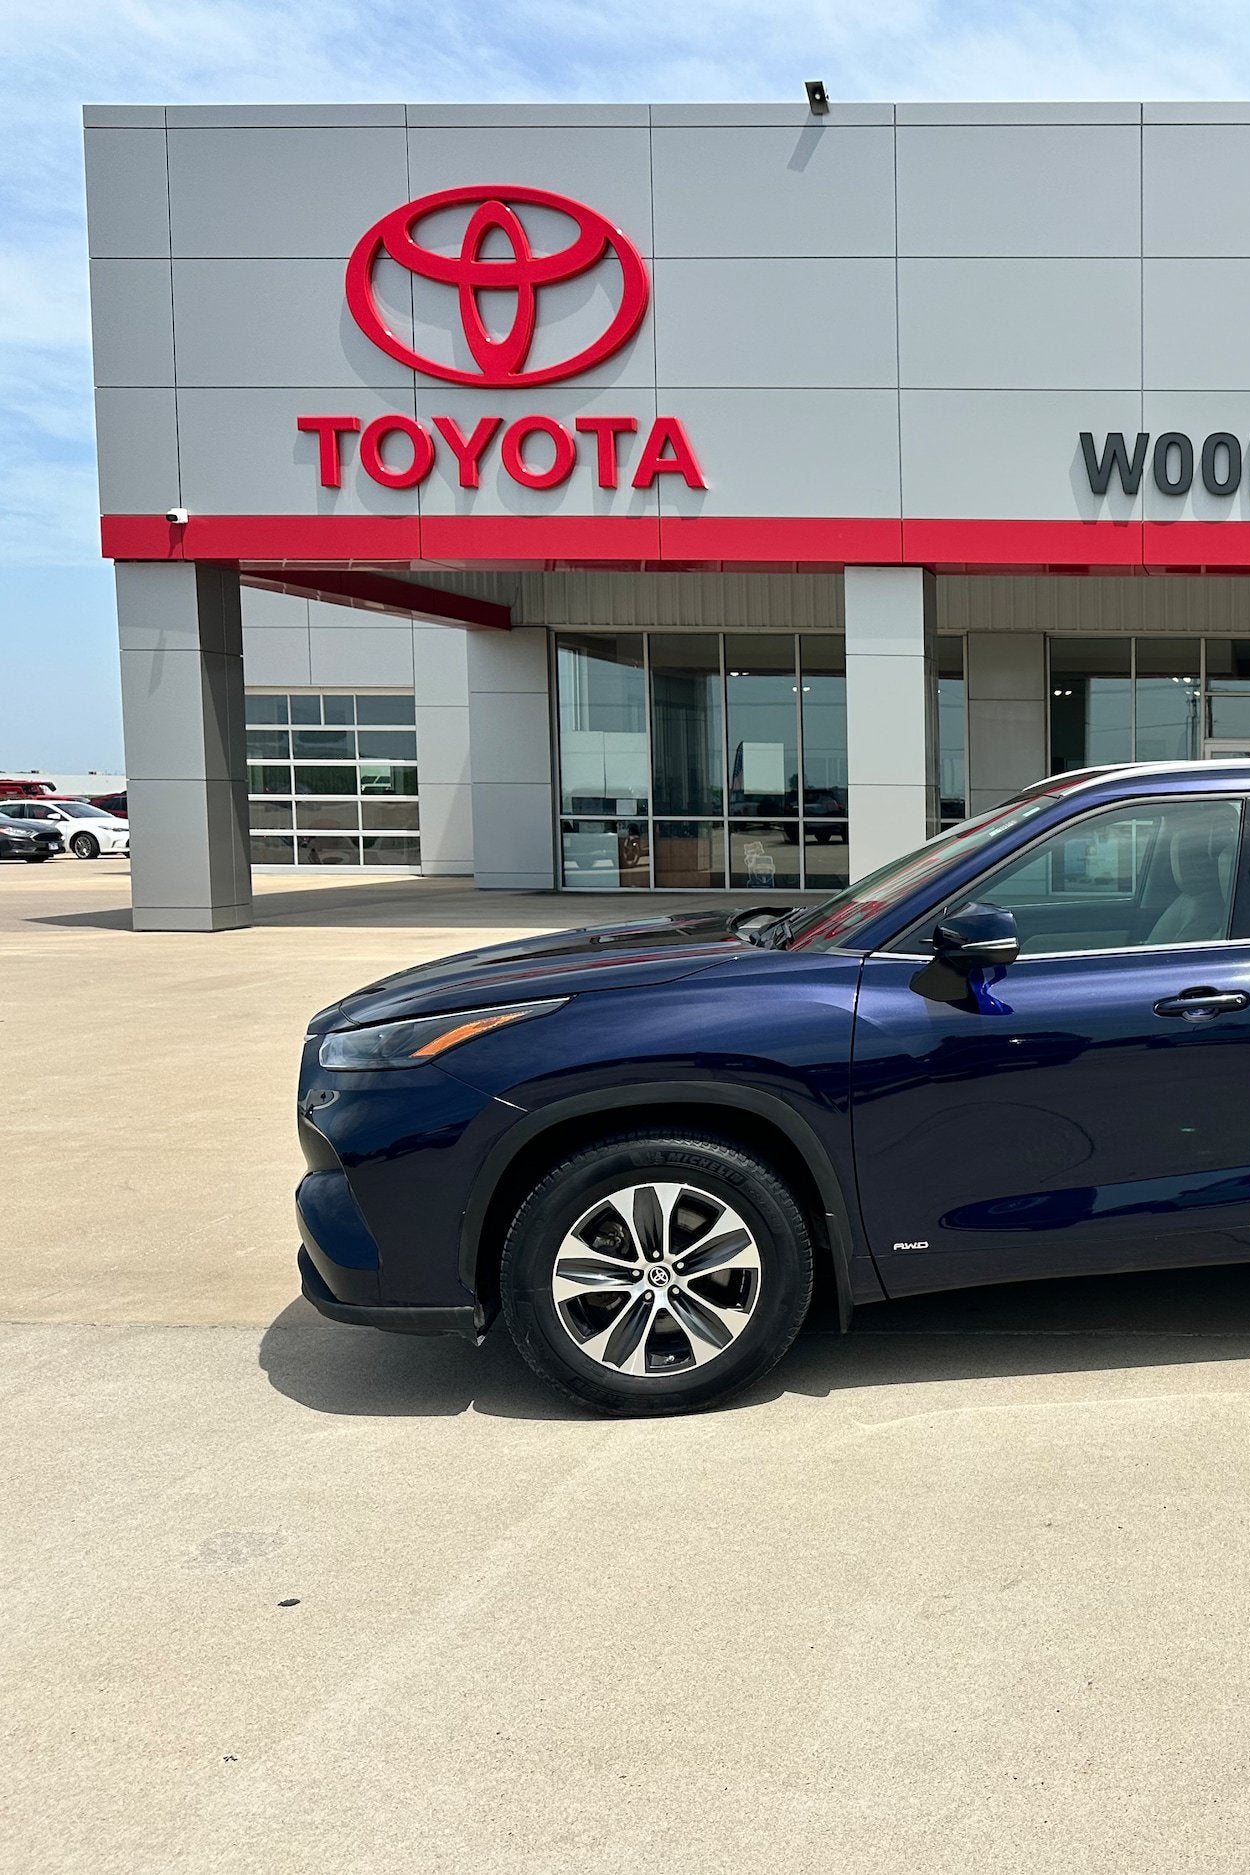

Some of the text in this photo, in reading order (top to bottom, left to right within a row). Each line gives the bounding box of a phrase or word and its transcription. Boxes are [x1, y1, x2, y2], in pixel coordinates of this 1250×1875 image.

[297, 414, 709, 490] TOYOTA
[667, 1151, 745, 1184] MICHELIN
[893, 1241, 929, 1250] AWD
